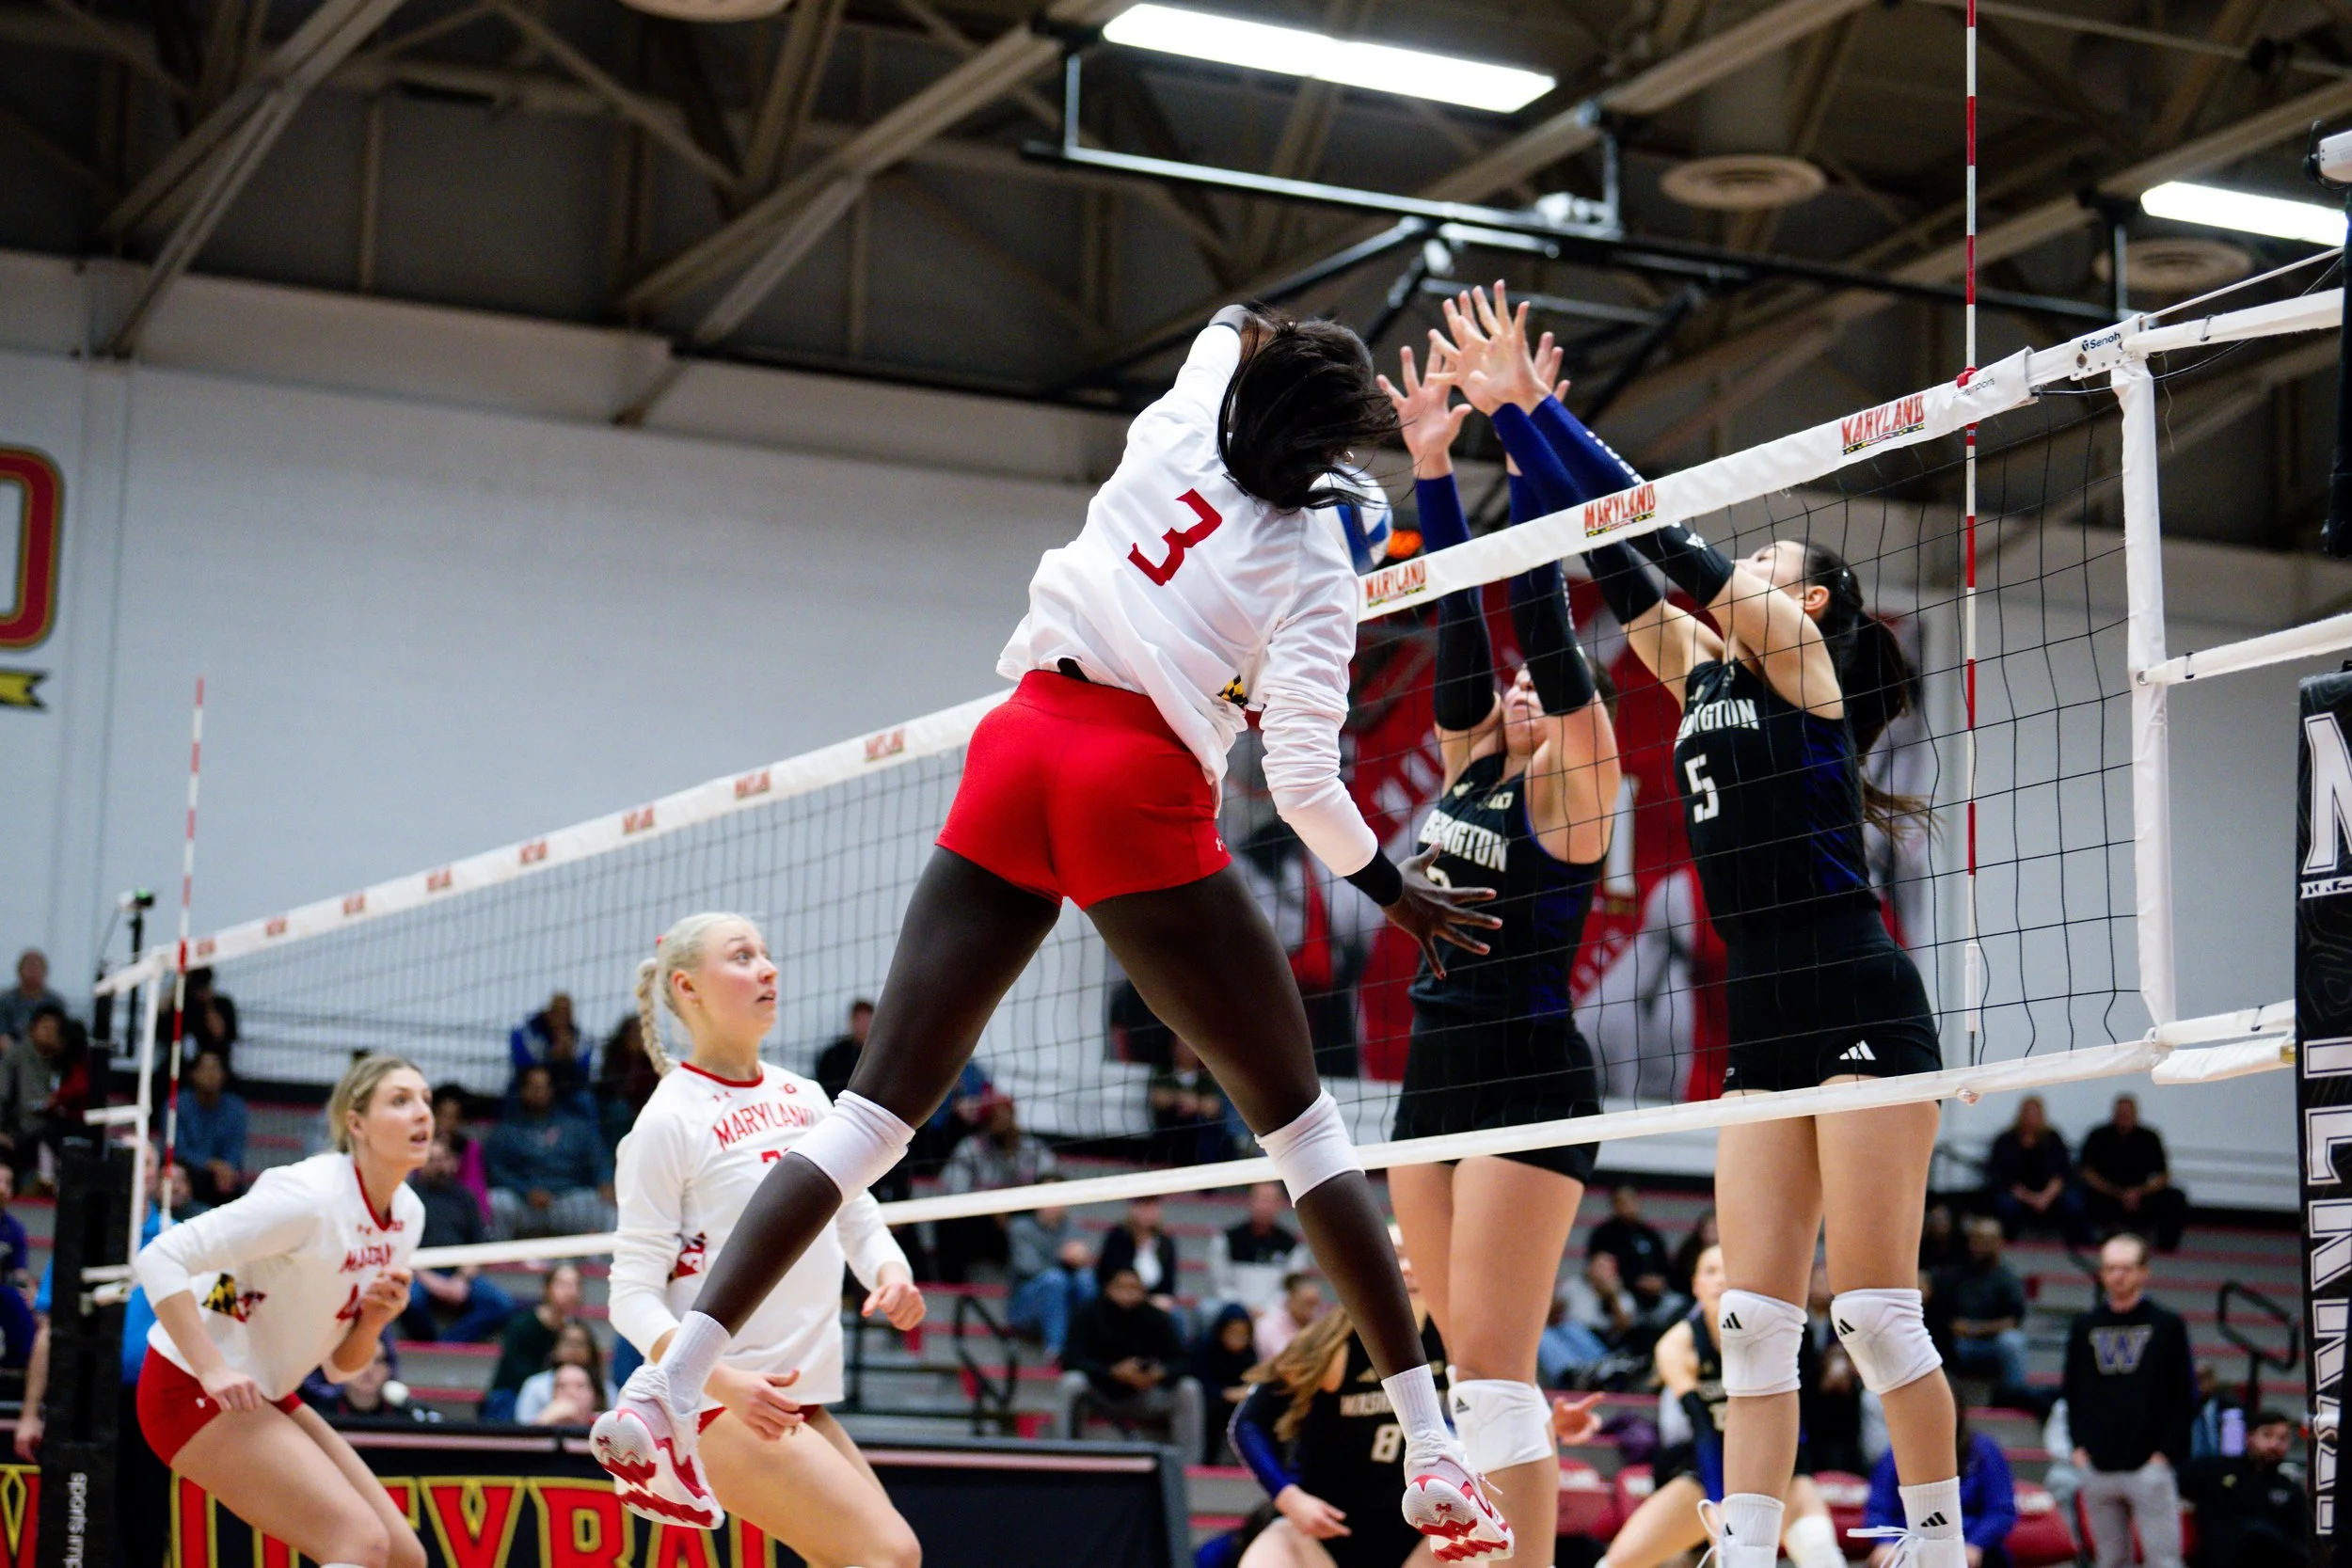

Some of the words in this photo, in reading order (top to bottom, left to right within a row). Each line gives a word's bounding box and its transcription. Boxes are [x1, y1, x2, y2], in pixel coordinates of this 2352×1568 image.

[2090, 331, 2122, 350] Senoh
[1841, 394, 1925, 449] MARYLAND
[1584, 483, 1656, 531] MARYLAND
[1127, 488, 1222, 587] 3
[1365, 559, 1426, 601] MARYLAND
[1685, 753, 1720, 824] 5
[712, 1101, 815, 1151] MARYLAND
[2088, 1324, 2153, 1375] W
[1371, 1423, 1403, 1463] 8
